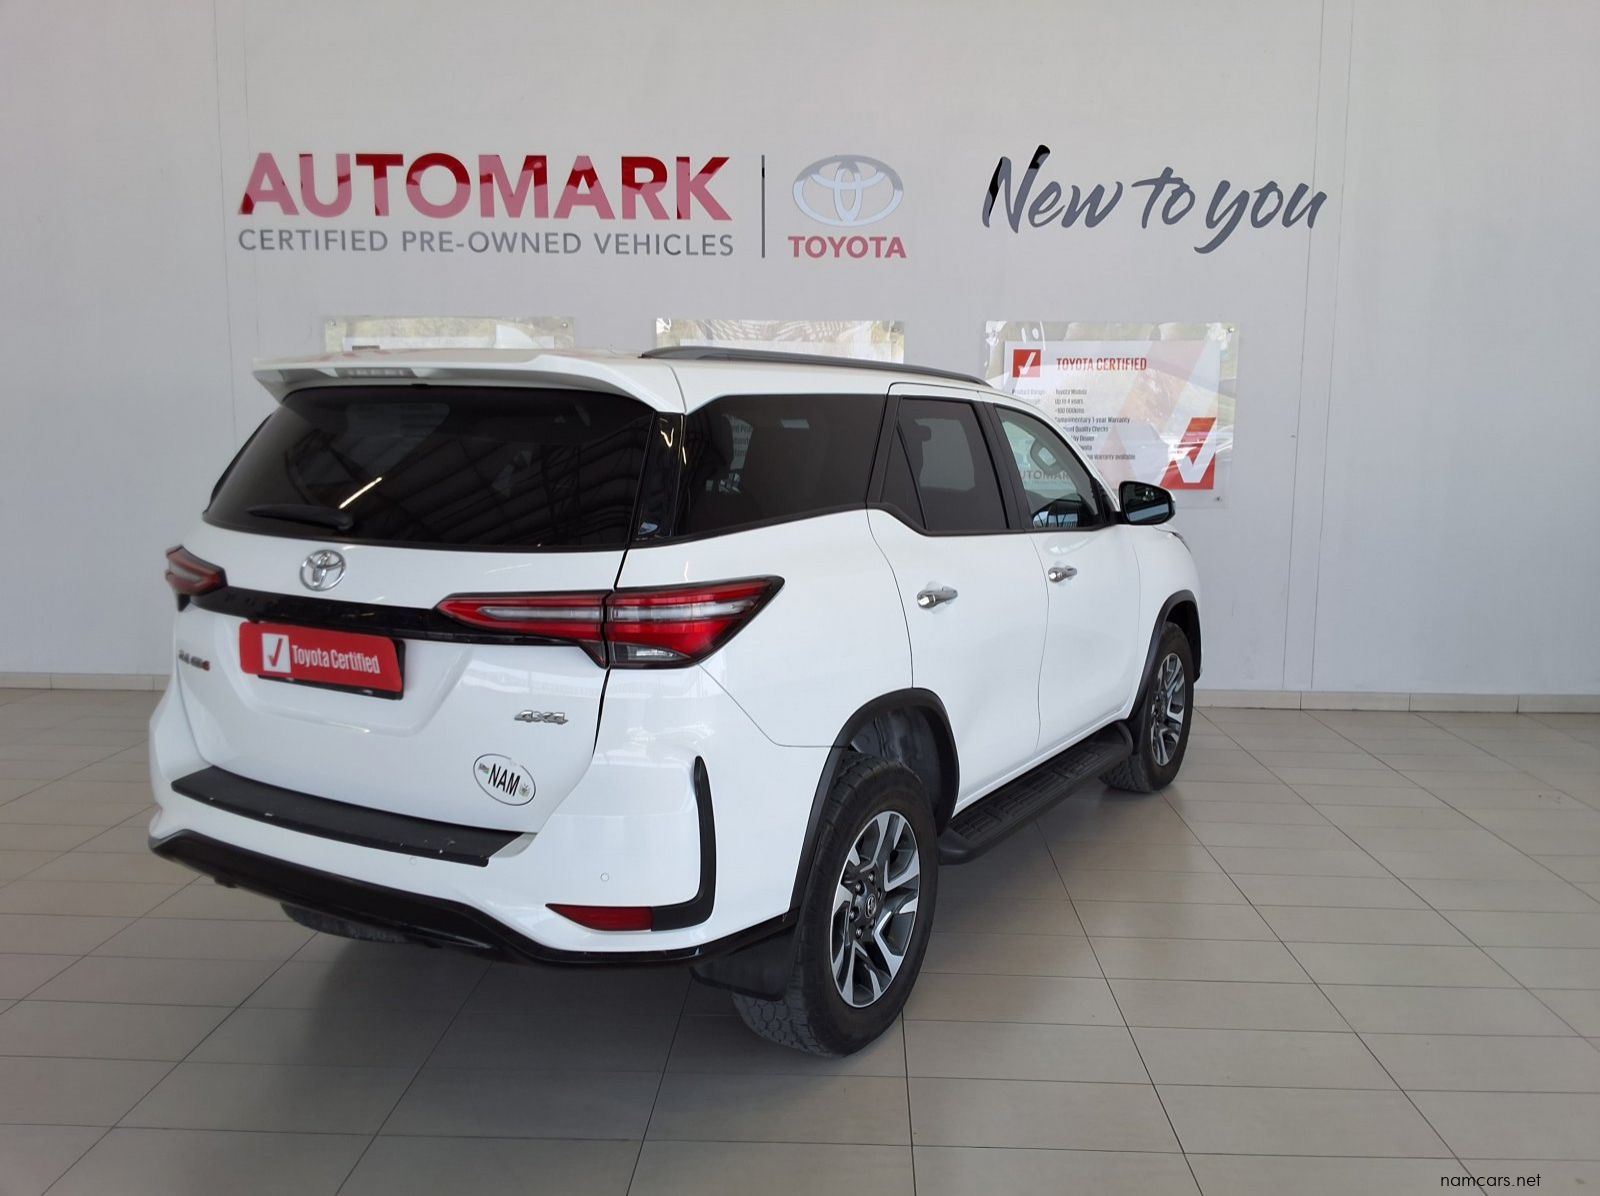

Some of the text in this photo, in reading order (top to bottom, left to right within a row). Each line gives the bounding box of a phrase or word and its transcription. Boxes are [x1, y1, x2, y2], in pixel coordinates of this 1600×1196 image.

[238, 152, 733, 221] AUTOMARK
[982, 144, 1328, 254] New to you
[238, 229, 733, 256] CERTIFIED PRE-OWNED VEHICLES
[788, 236, 907, 259] TOYOTA
[1056, 357, 1147, 371] TOYOTA CERTIFIED
[291, 645, 381, 674] Toyota Certified
[487, 763, 521, 797] NAM
